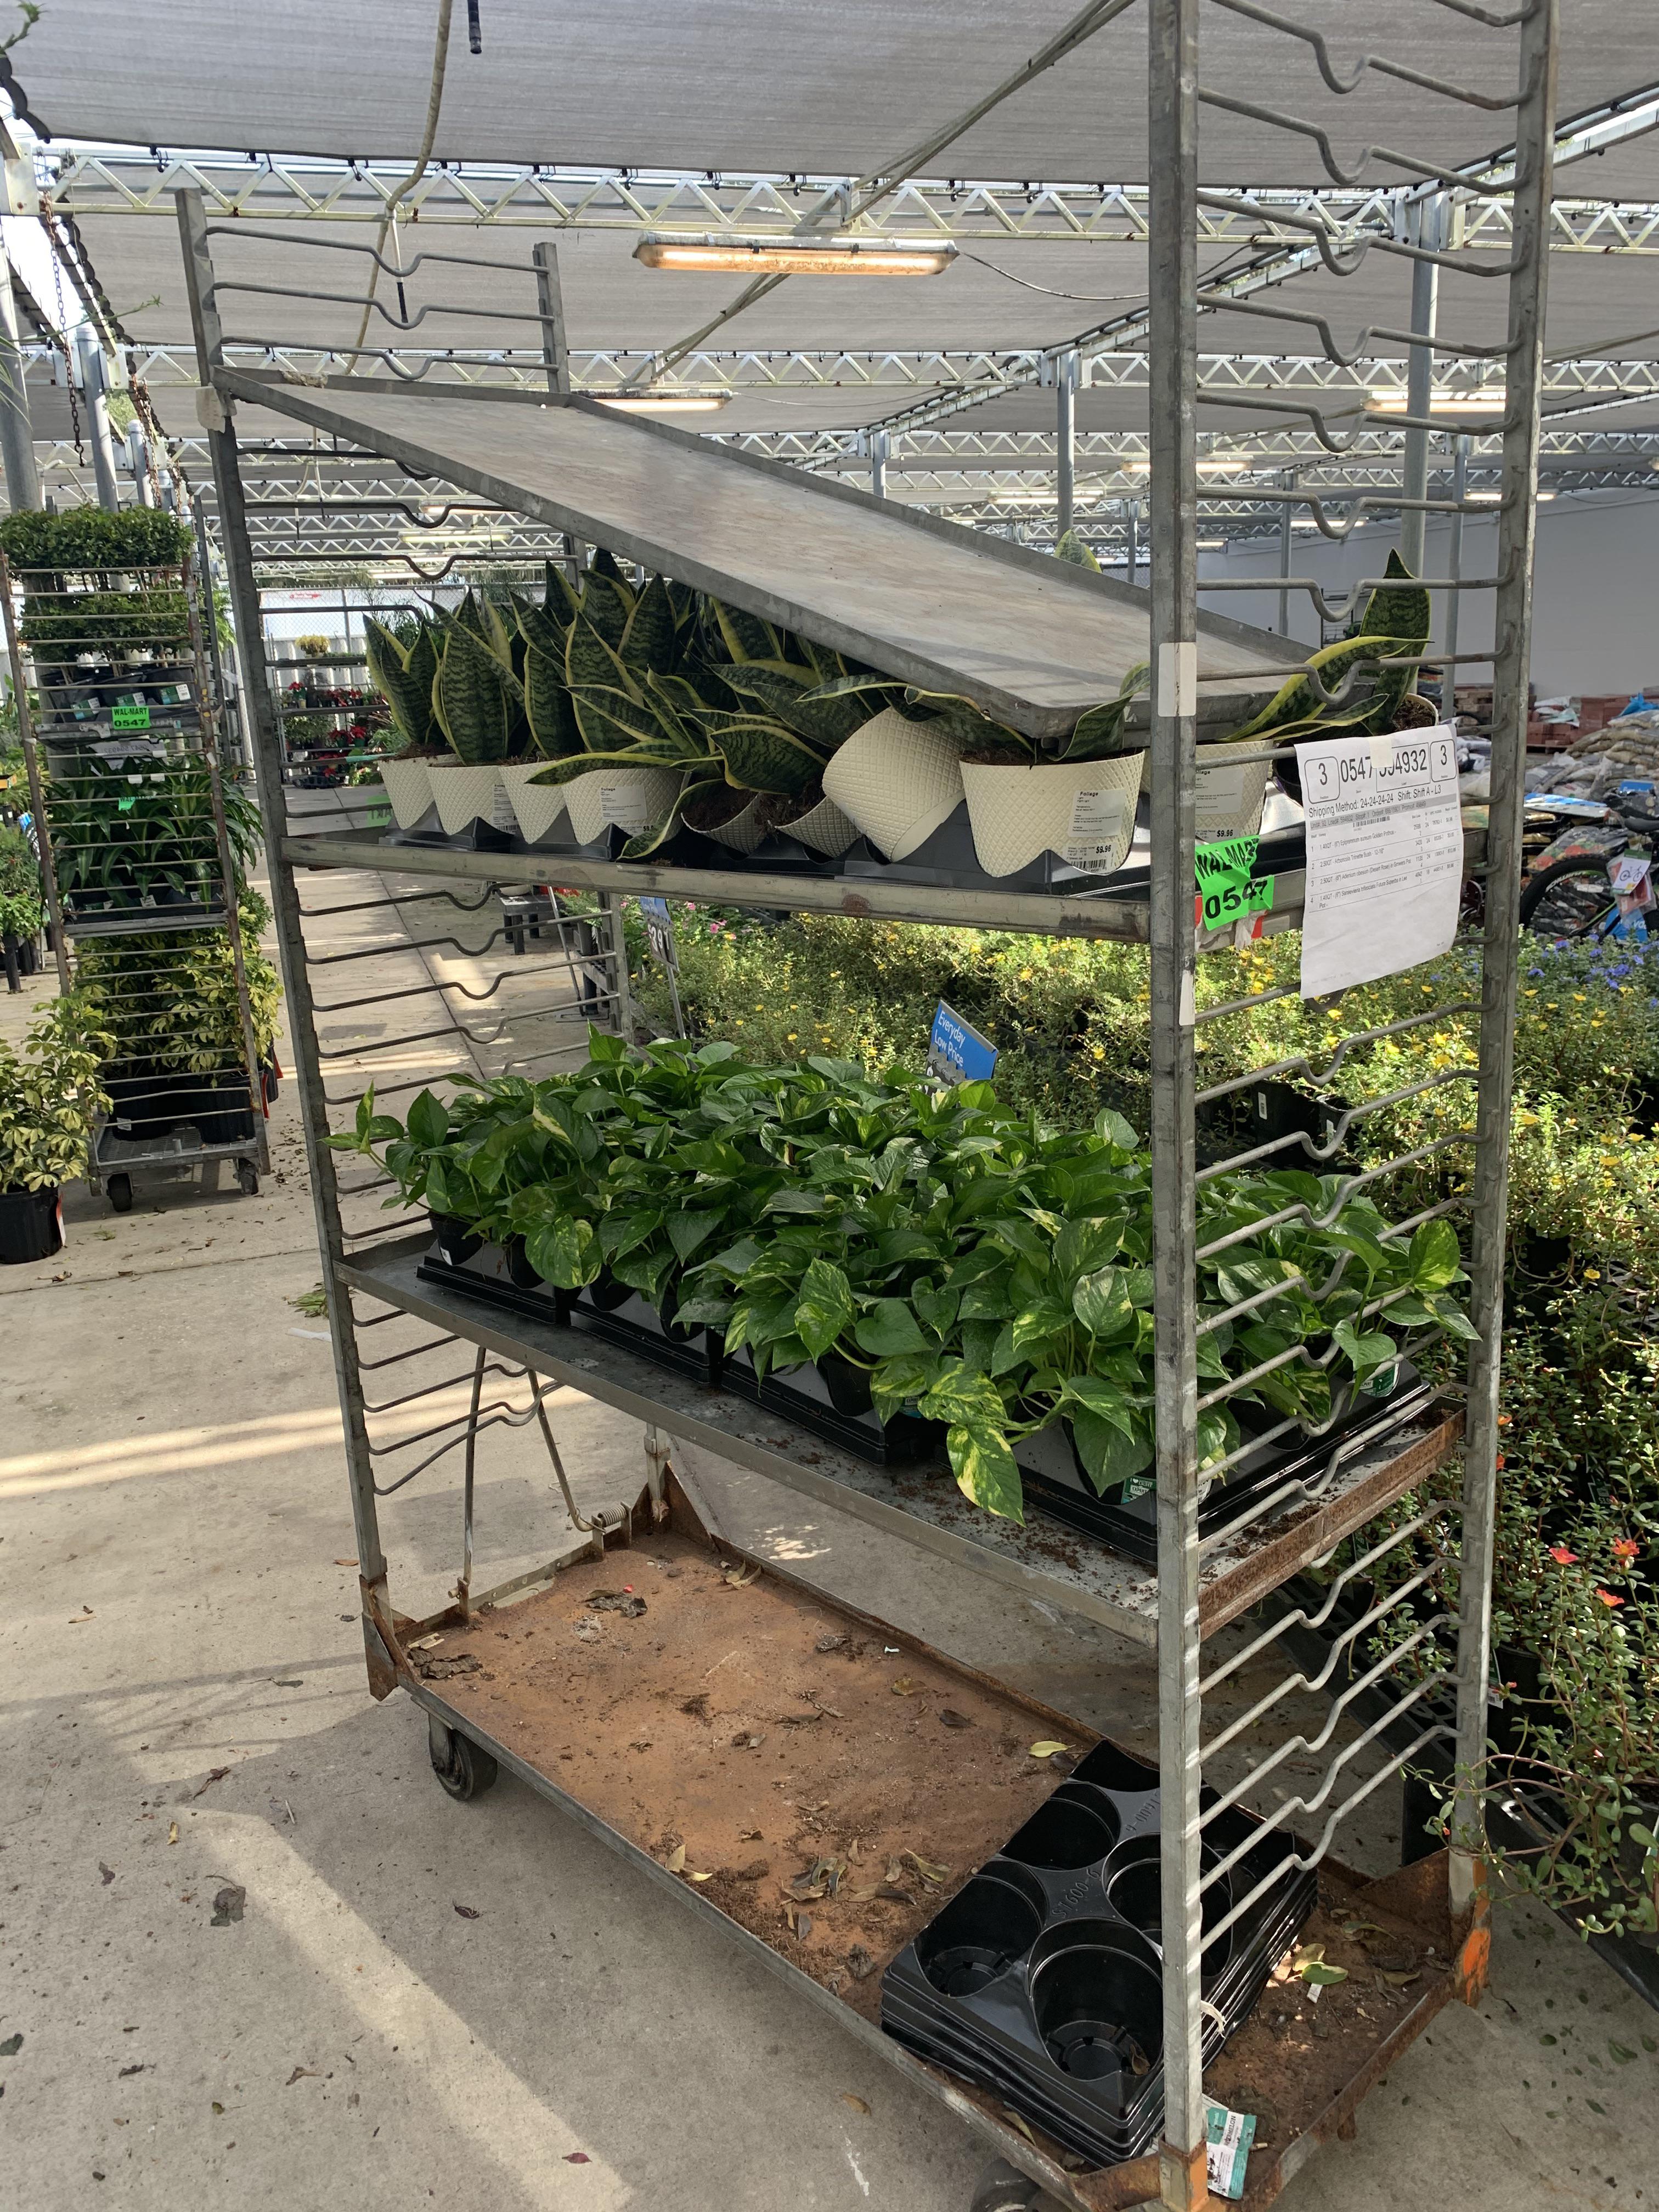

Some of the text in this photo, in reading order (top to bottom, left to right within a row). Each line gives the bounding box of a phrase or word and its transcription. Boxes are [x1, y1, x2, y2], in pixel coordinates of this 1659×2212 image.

[1318, 763, 1328, 786] 3
[1340, 756, 1372, 783] 0547
[1440, 744, 1447, 766] 3
[1309, 805, 1335, 819] Shipping
[1336, 800, 1359, 813] Method:
[1361, 793, 1394, 808] 24-24-24-24
[1398, 789, 1411, 802] Shift:
[1413, 787, 1425, 799] Shift
[1426, 786, 1430, 795] A
[1435, 785, 1441, 794] L3
[1096, 845, 1111, 854] $9.96
[1217, 829, 1233, 837] $9.96
[1205, 880, 1268, 919] 0547
[934, 1029, 964, 1066] Low Price
[938, 1010, 966, 1049] Everyday
